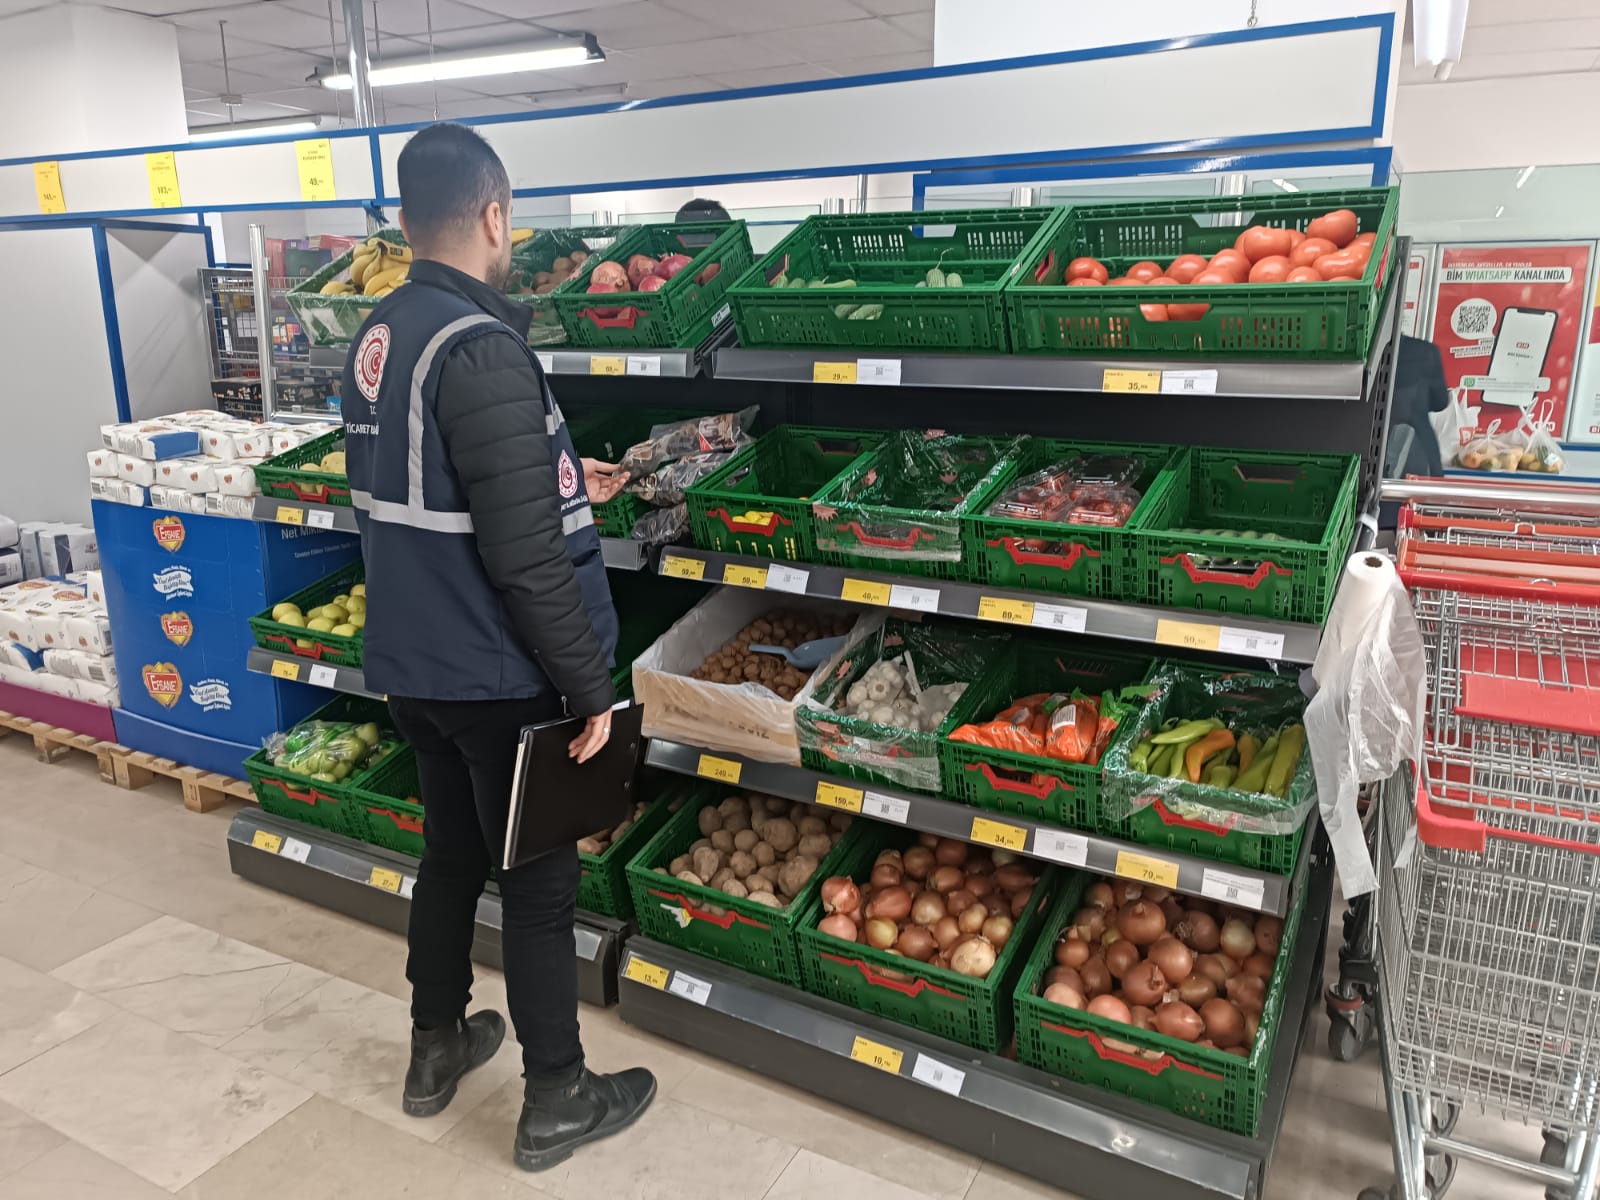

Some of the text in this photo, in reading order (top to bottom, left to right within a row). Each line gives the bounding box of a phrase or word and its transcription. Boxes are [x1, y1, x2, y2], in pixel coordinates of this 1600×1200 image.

[1446, 269, 1565, 281] BİM WHATSAPP KANALINDA
[281, 528, 298, 540] Net
